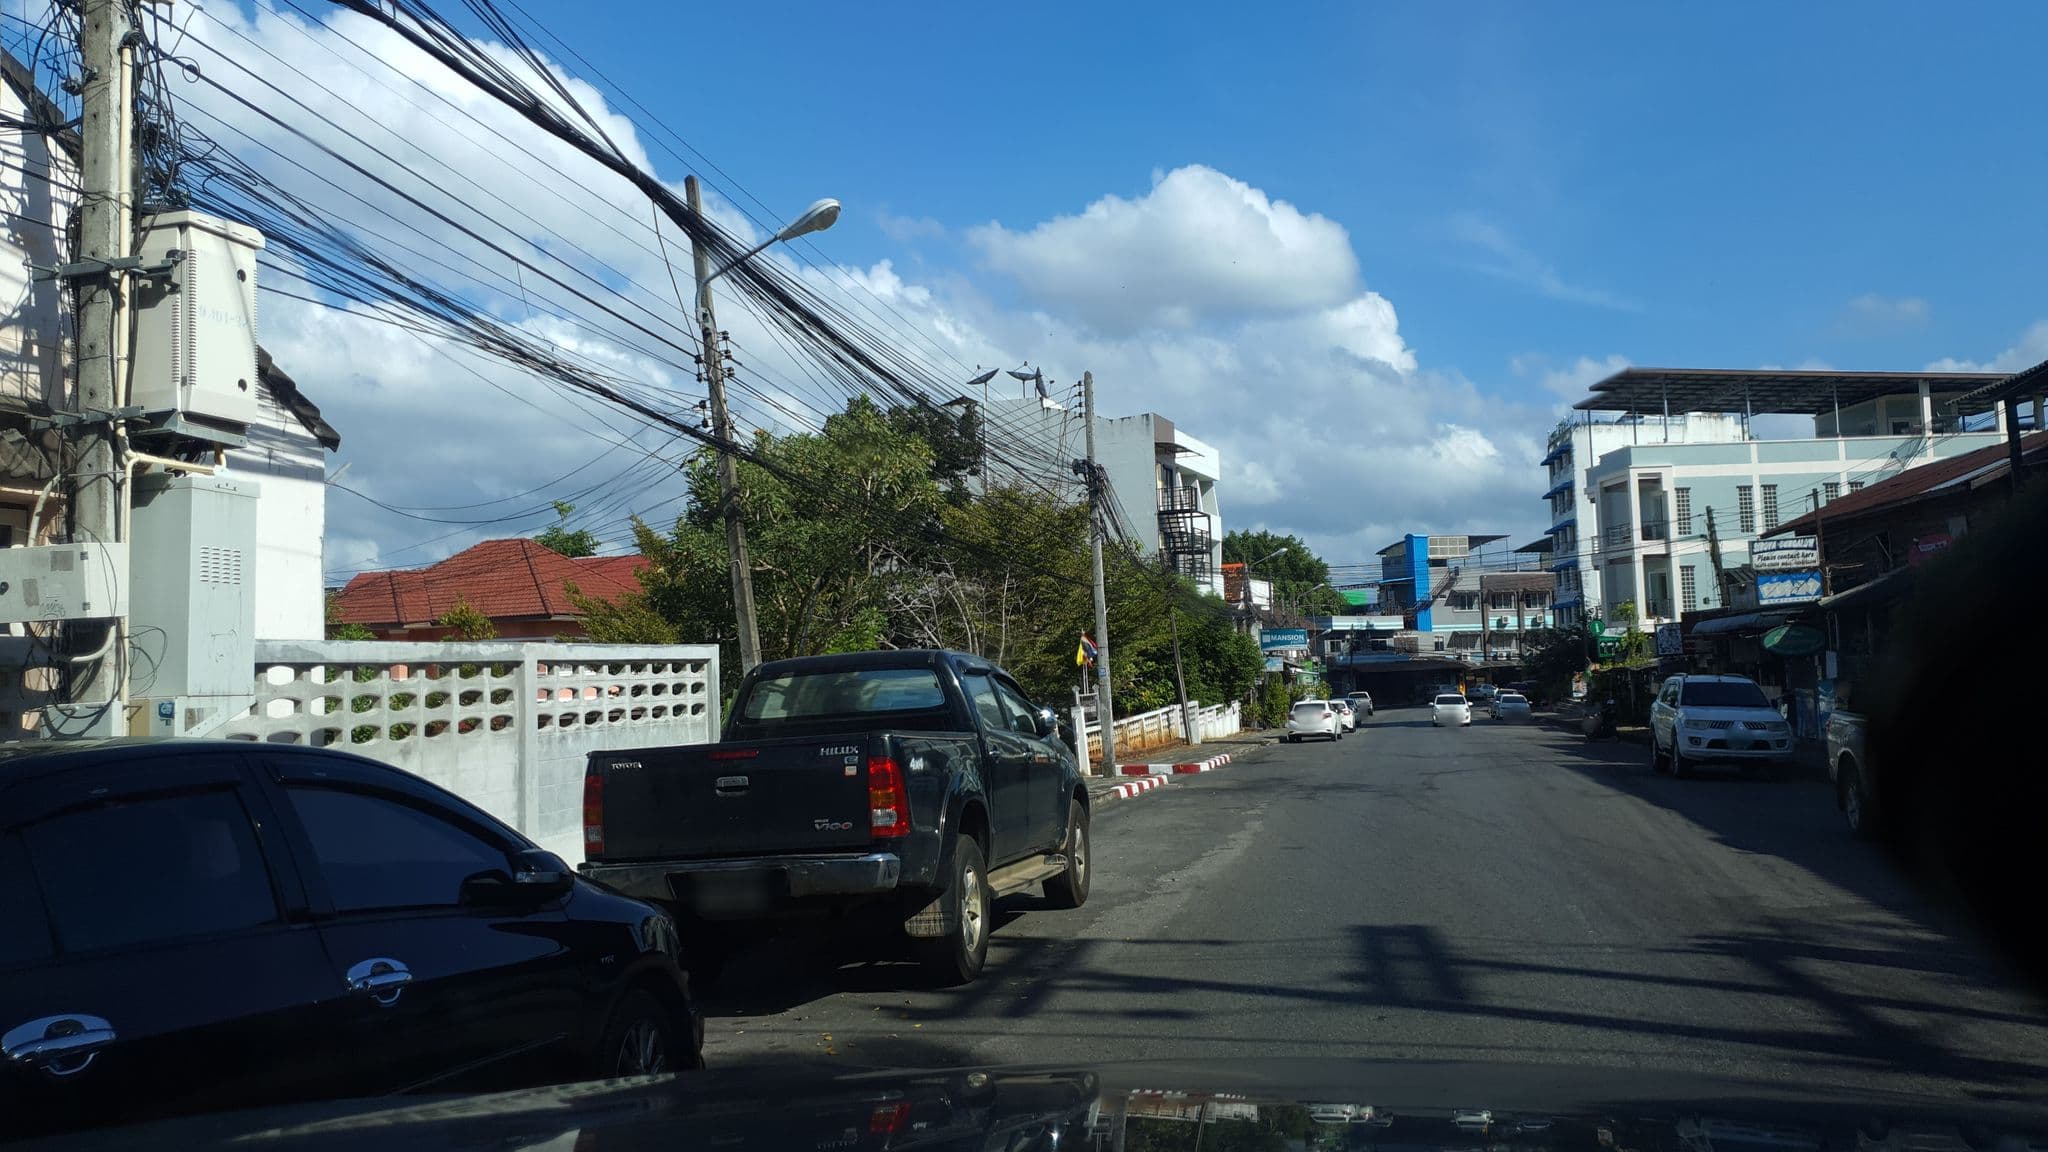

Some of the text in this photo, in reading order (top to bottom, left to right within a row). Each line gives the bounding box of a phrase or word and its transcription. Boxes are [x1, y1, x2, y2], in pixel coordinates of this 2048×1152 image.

[1777, 552, 1800, 560] contact
[820, 745, 859, 756] HILUX
[611, 762, 642, 770] TOYOTA
